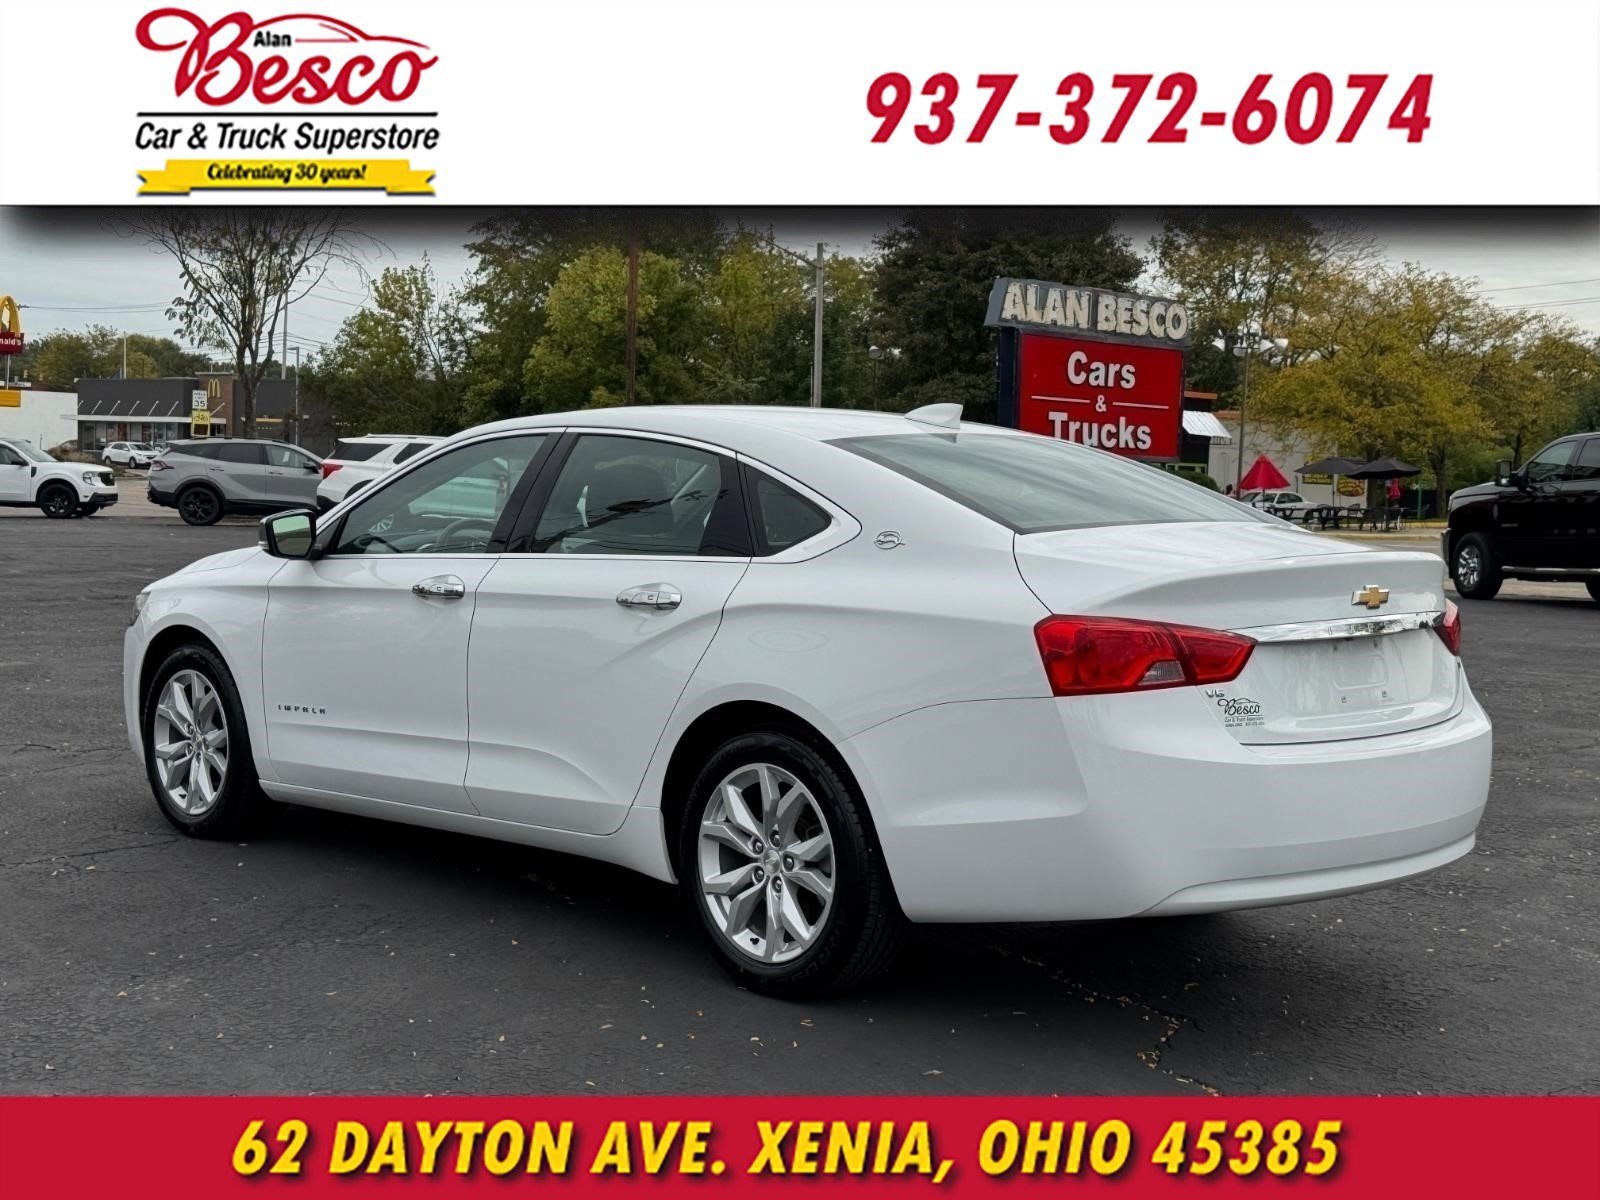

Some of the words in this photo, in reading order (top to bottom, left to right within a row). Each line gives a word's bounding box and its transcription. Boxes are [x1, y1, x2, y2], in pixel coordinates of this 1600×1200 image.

[1002, 282, 1090, 329] ALAN
[1097, 294, 1189, 340] BESCO
[1067, 350, 1136, 389] Cars
[1095, 394, 1107, 413] &
[1048, 411, 1152, 450] Trucks
[1217, 697, 1260, 716] Besco
